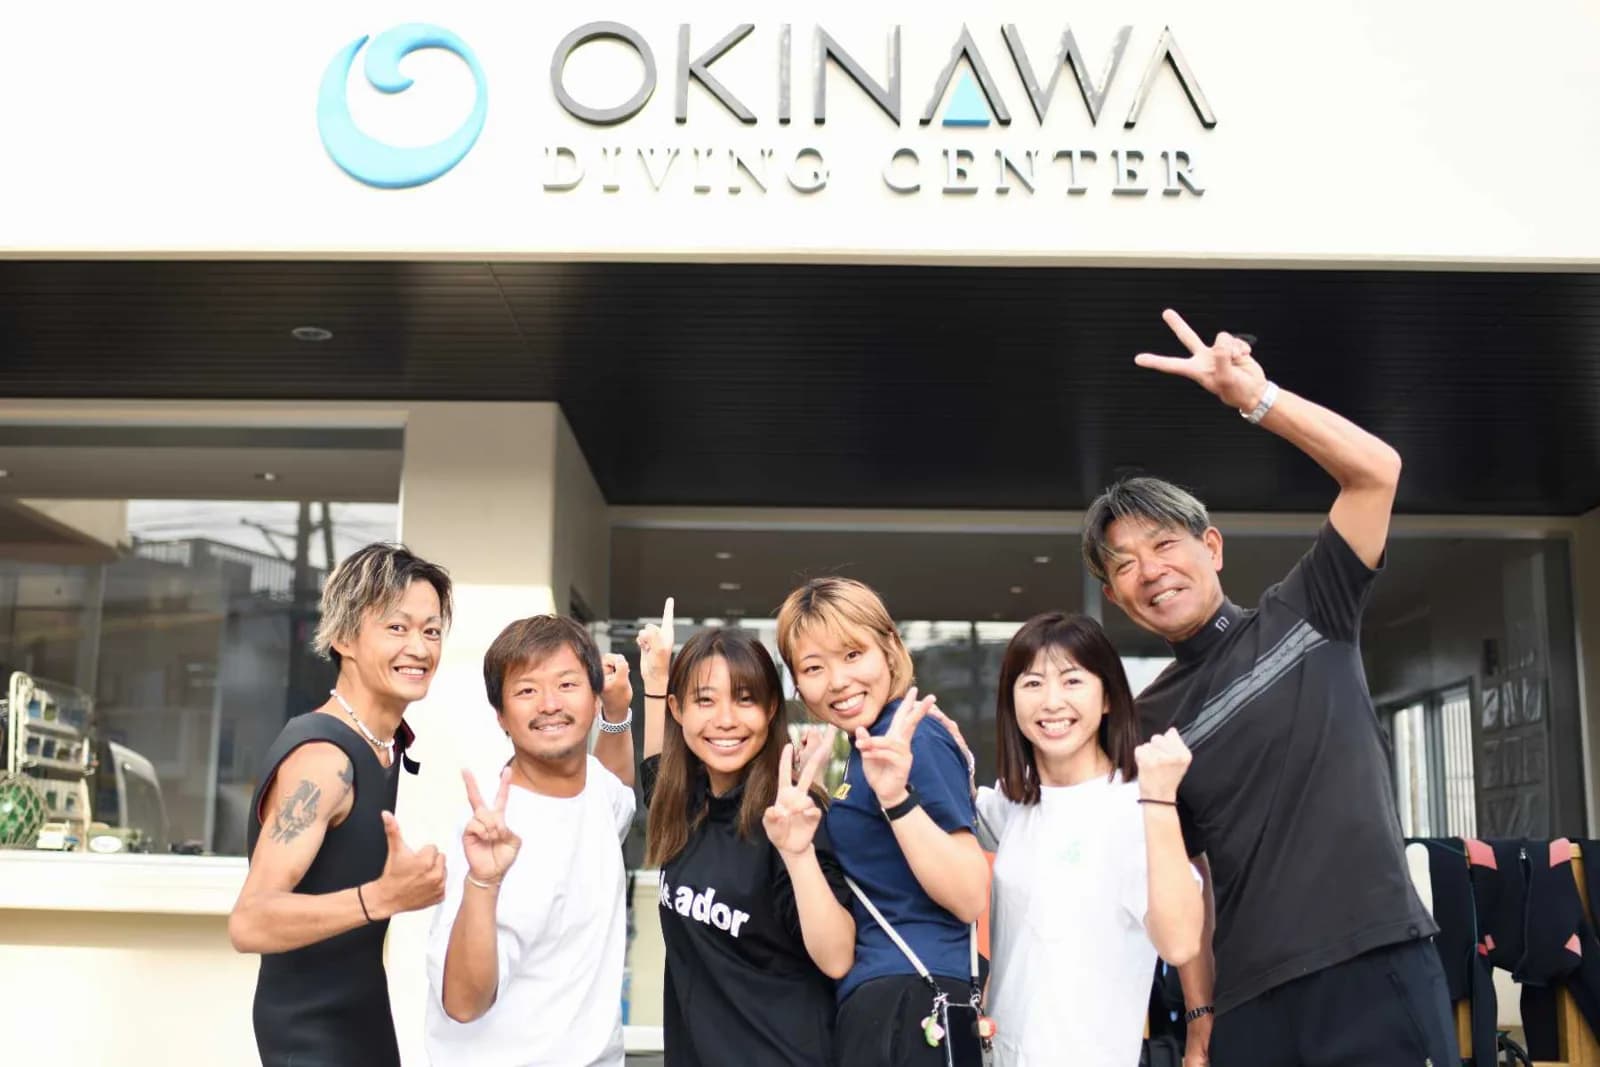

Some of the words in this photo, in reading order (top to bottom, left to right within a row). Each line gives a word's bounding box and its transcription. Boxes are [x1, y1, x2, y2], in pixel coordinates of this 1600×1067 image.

[550, 20, 1217, 128] OKINAWA
[543, 146, 831, 194] DIVING
[882, 147, 1205, 196] CENTER
